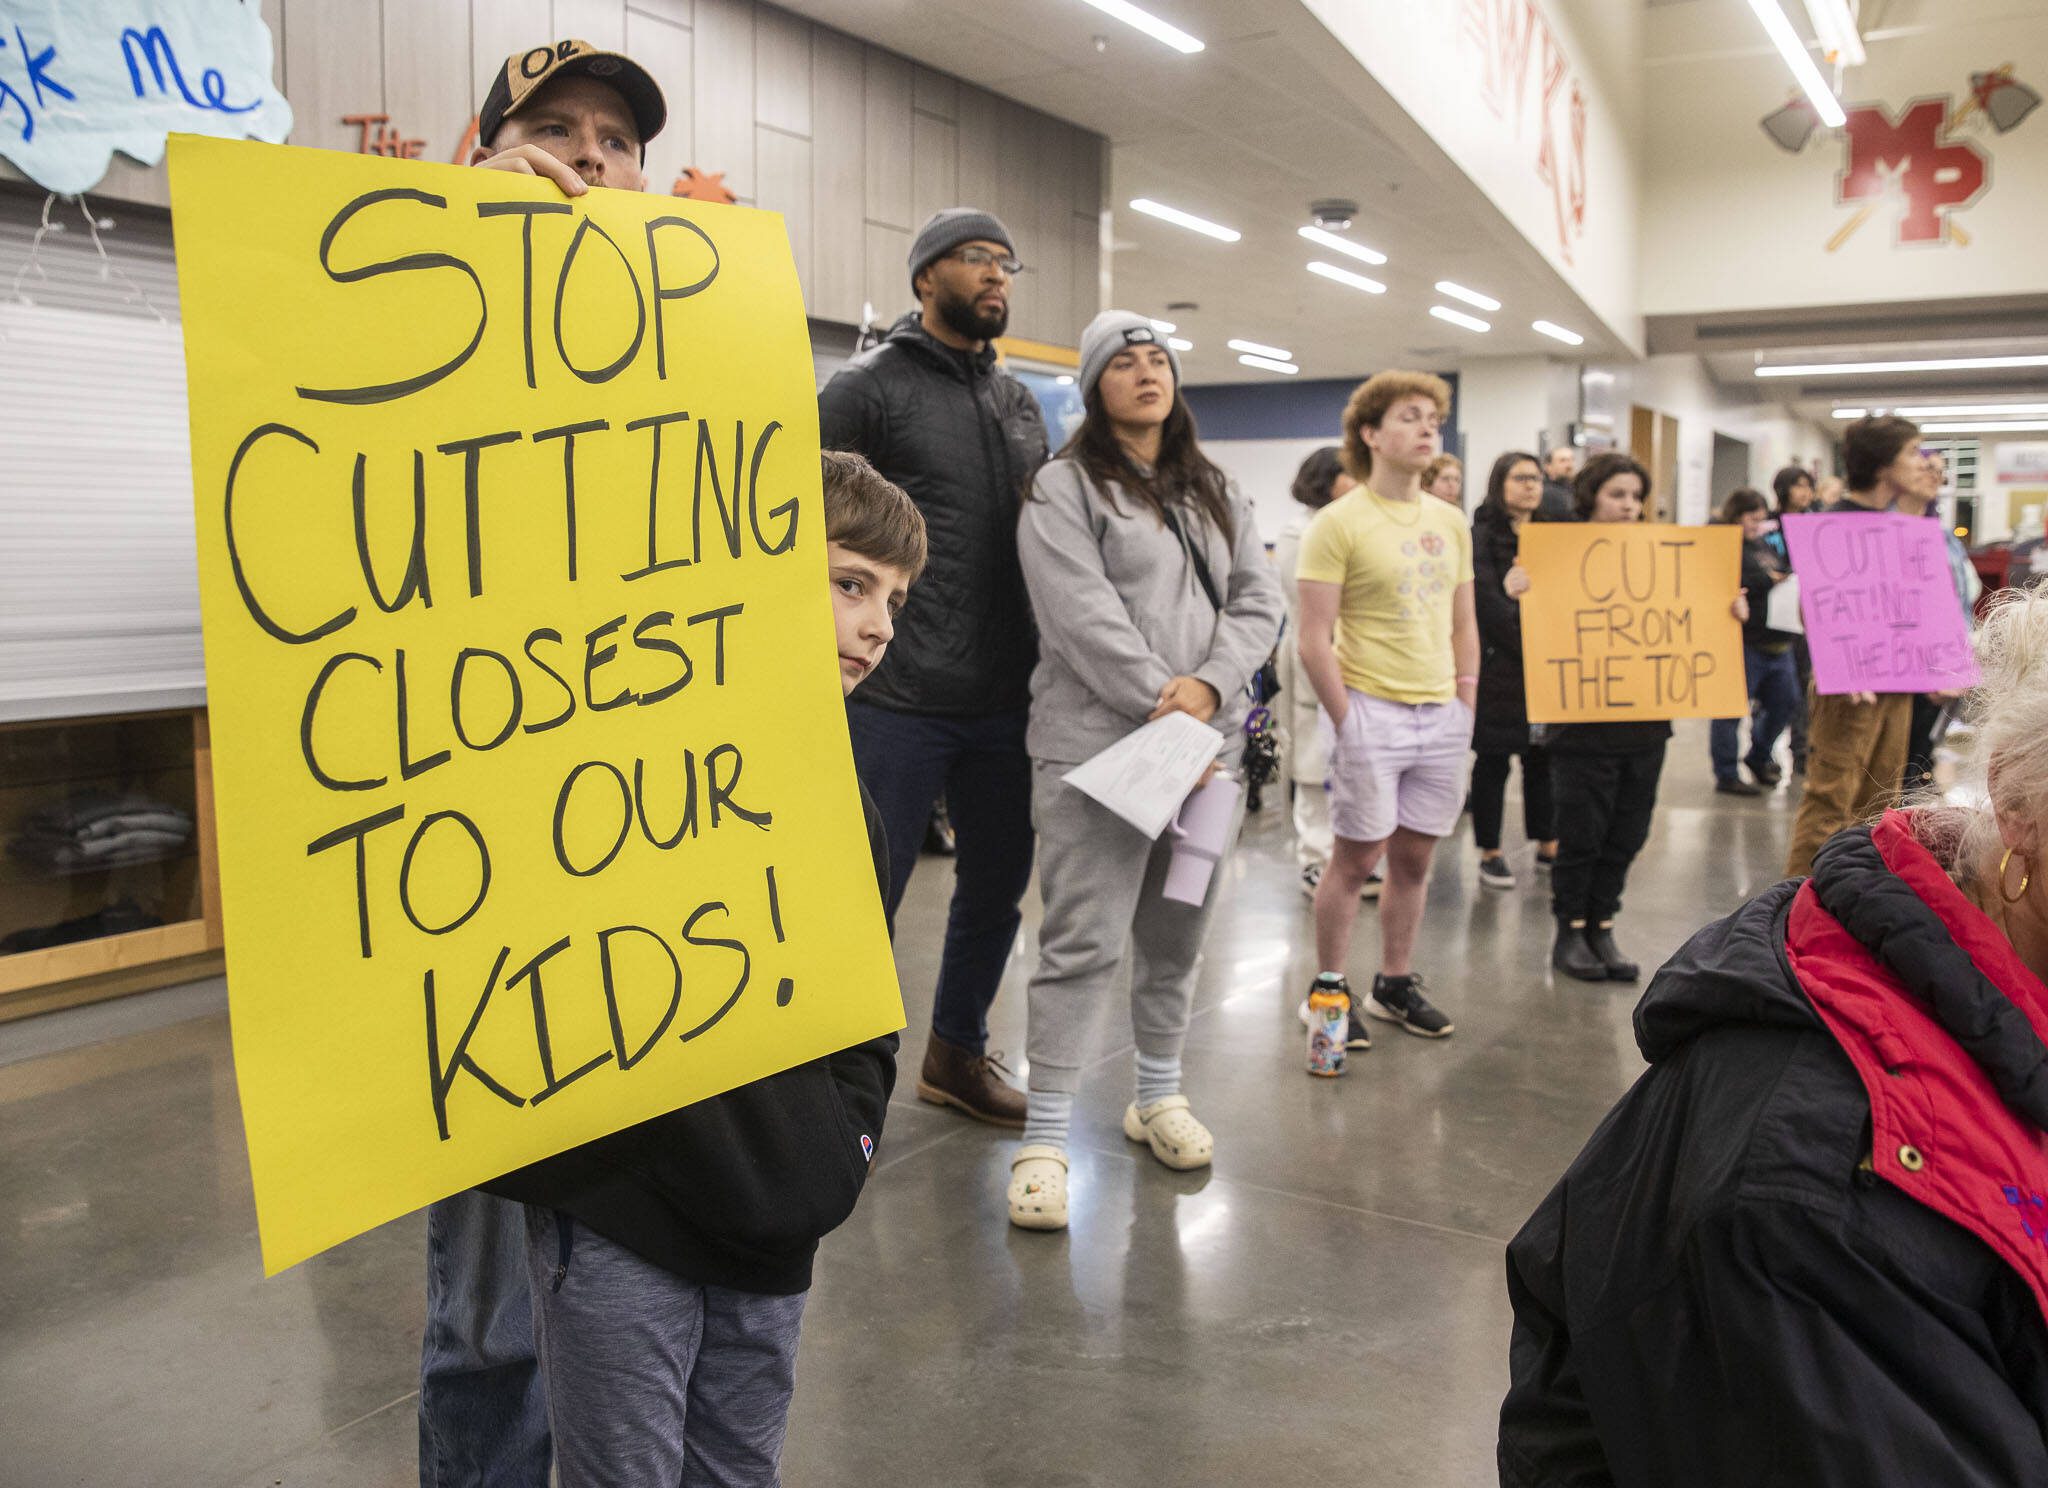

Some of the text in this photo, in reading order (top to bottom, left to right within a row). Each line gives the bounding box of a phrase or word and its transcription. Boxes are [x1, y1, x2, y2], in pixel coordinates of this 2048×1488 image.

[121, 26, 263, 114] Me
[1835, 95, 1993, 246] MP
[296, 188, 720, 405] STOP
[224, 411, 800, 644] CUTTING
[1580, 538, 1696, 603] CUT
[1812, 519, 1887, 582] CUT
[300, 603, 744, 791] CLOSEST
[1546, 651, 1717, 710] THE TOP
[1574, 603, 1693, 654] FROM
[307, 743, 772, 958] TO OUR
[424, 865, 794, 1141] KIDS!
